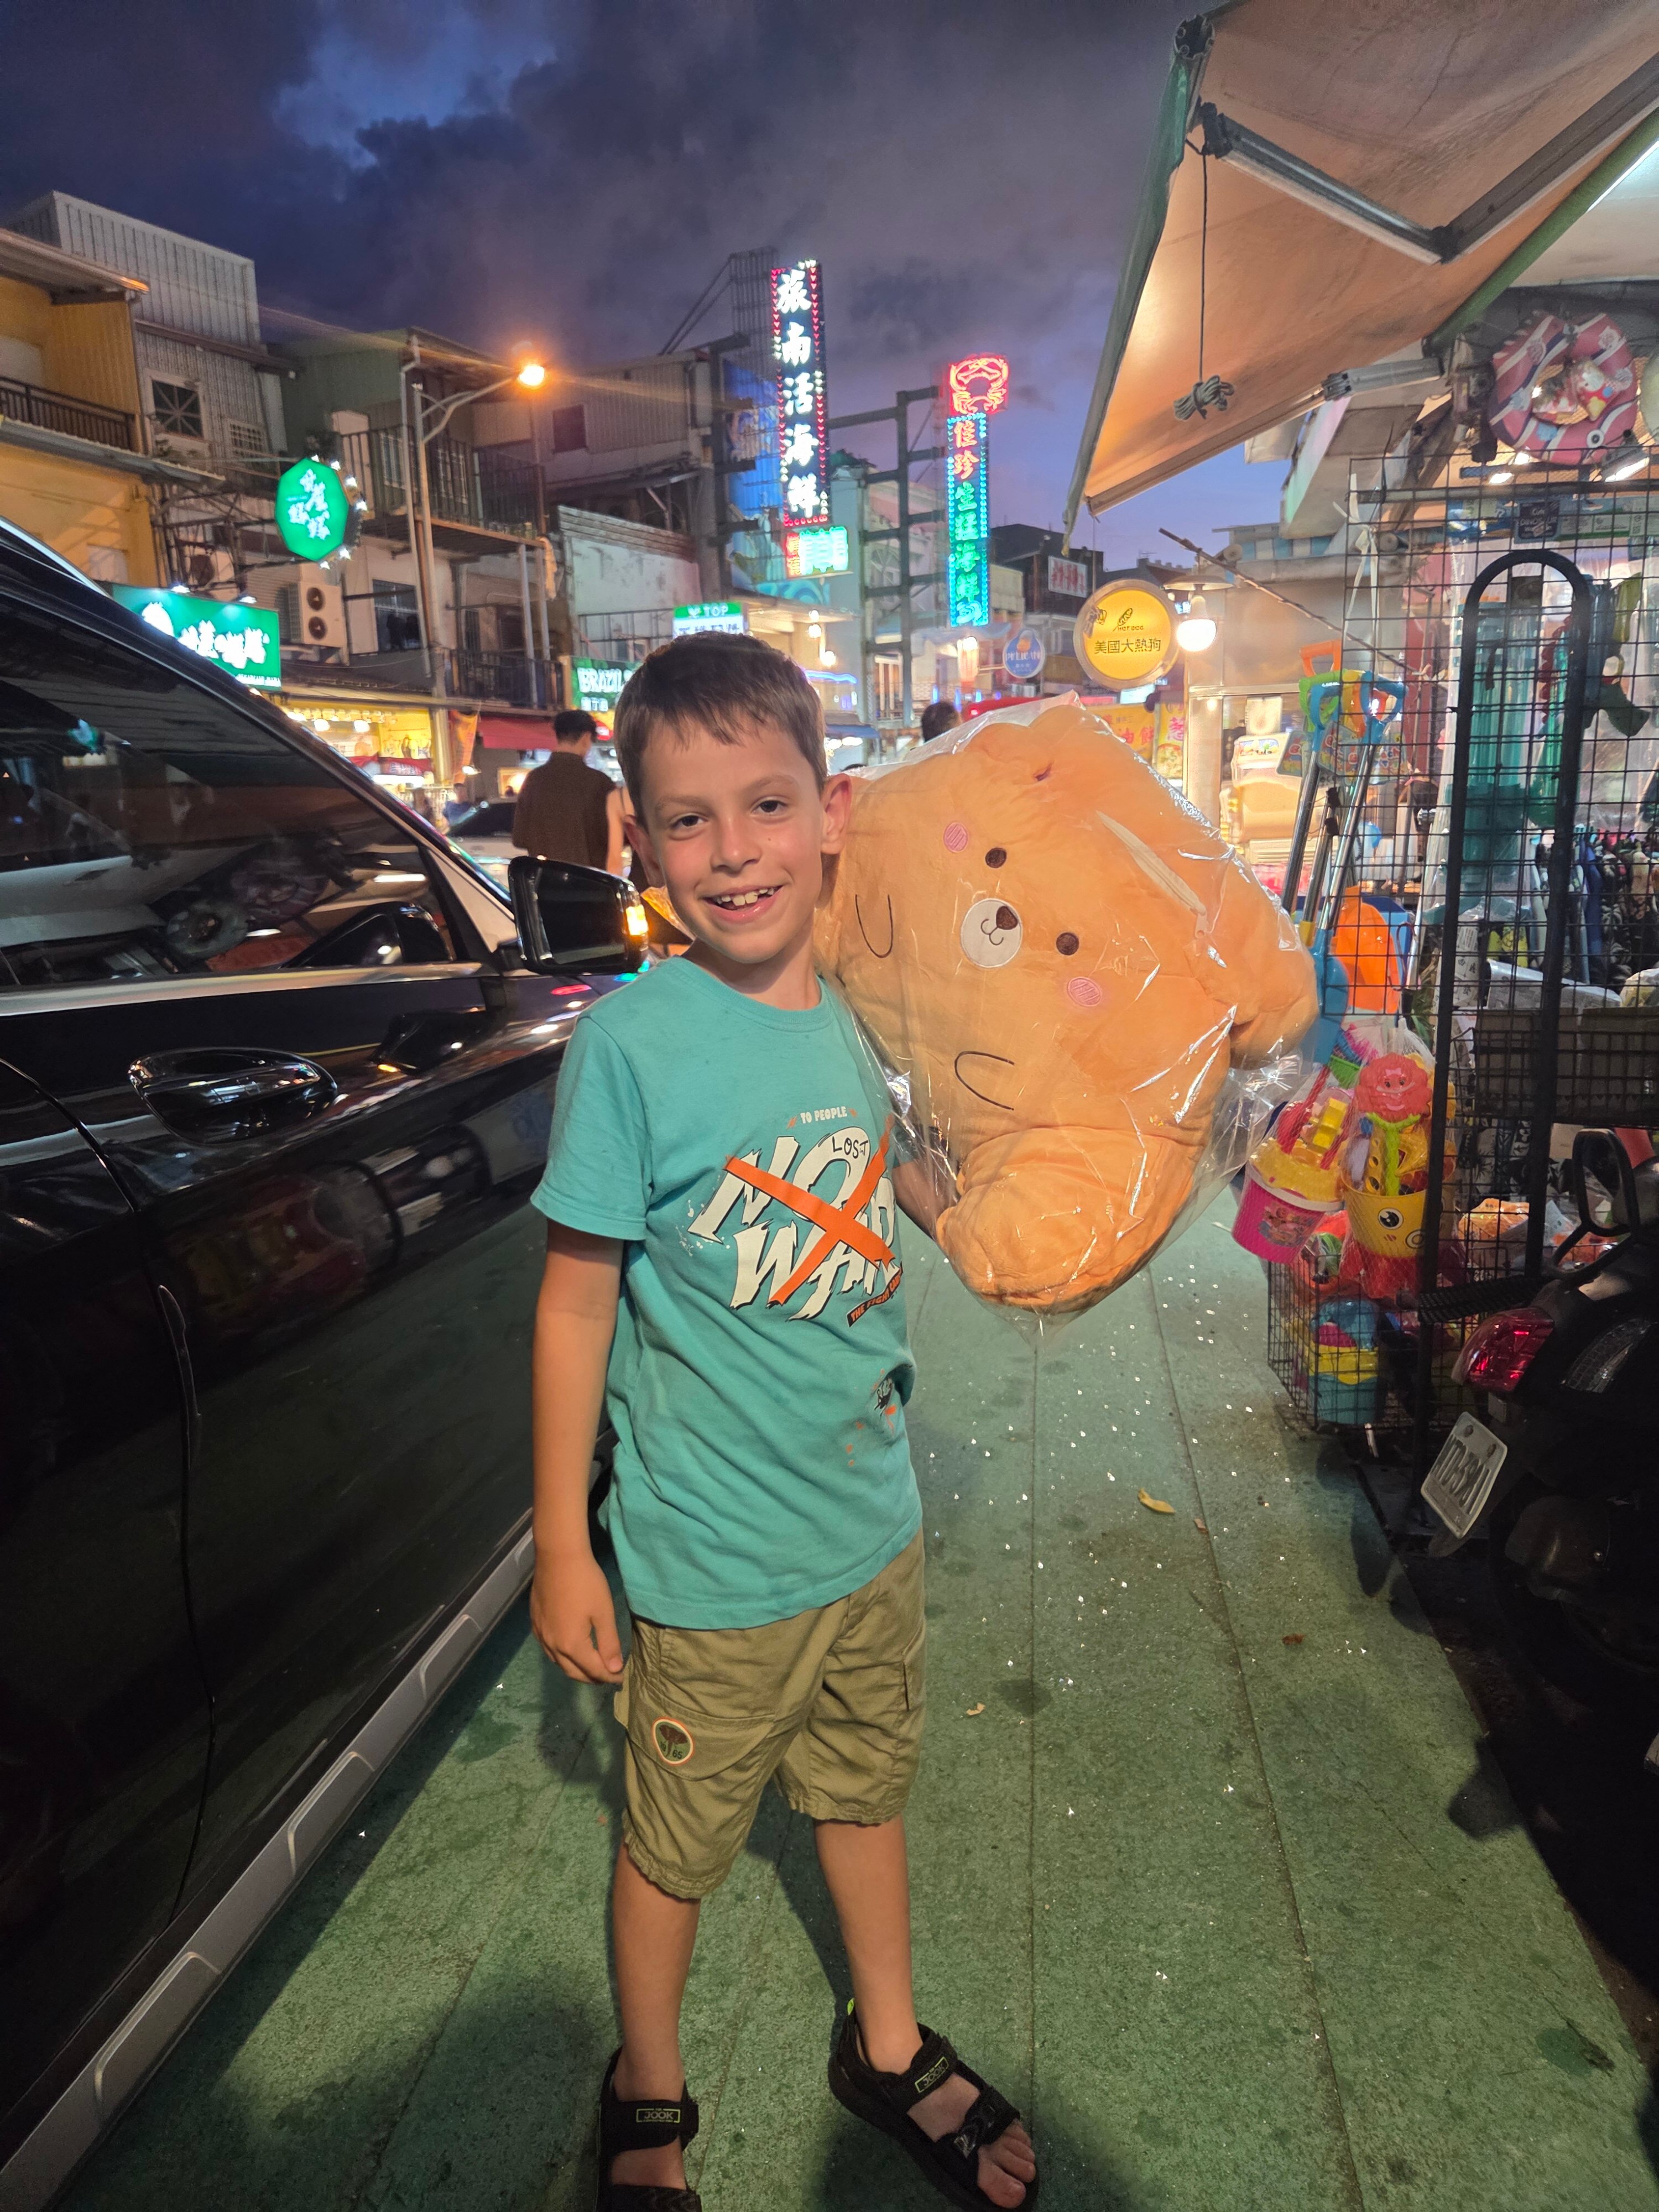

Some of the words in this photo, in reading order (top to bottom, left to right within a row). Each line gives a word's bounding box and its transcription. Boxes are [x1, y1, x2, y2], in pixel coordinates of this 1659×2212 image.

[1094, 638, 1161, 654] 美國大熱狗
[577, 667, 623, 692] BRAZIL
[800, 1112, 812, 1124] TO
[814, 1106, 847, 1121] PEOPLE
[832, 1136, 868, 1159] LOST
[851, 1303, 865, 1322] THE
[672, 1749, 682, 1759] 65
[644, 2111, 674, 2120] JOOK
